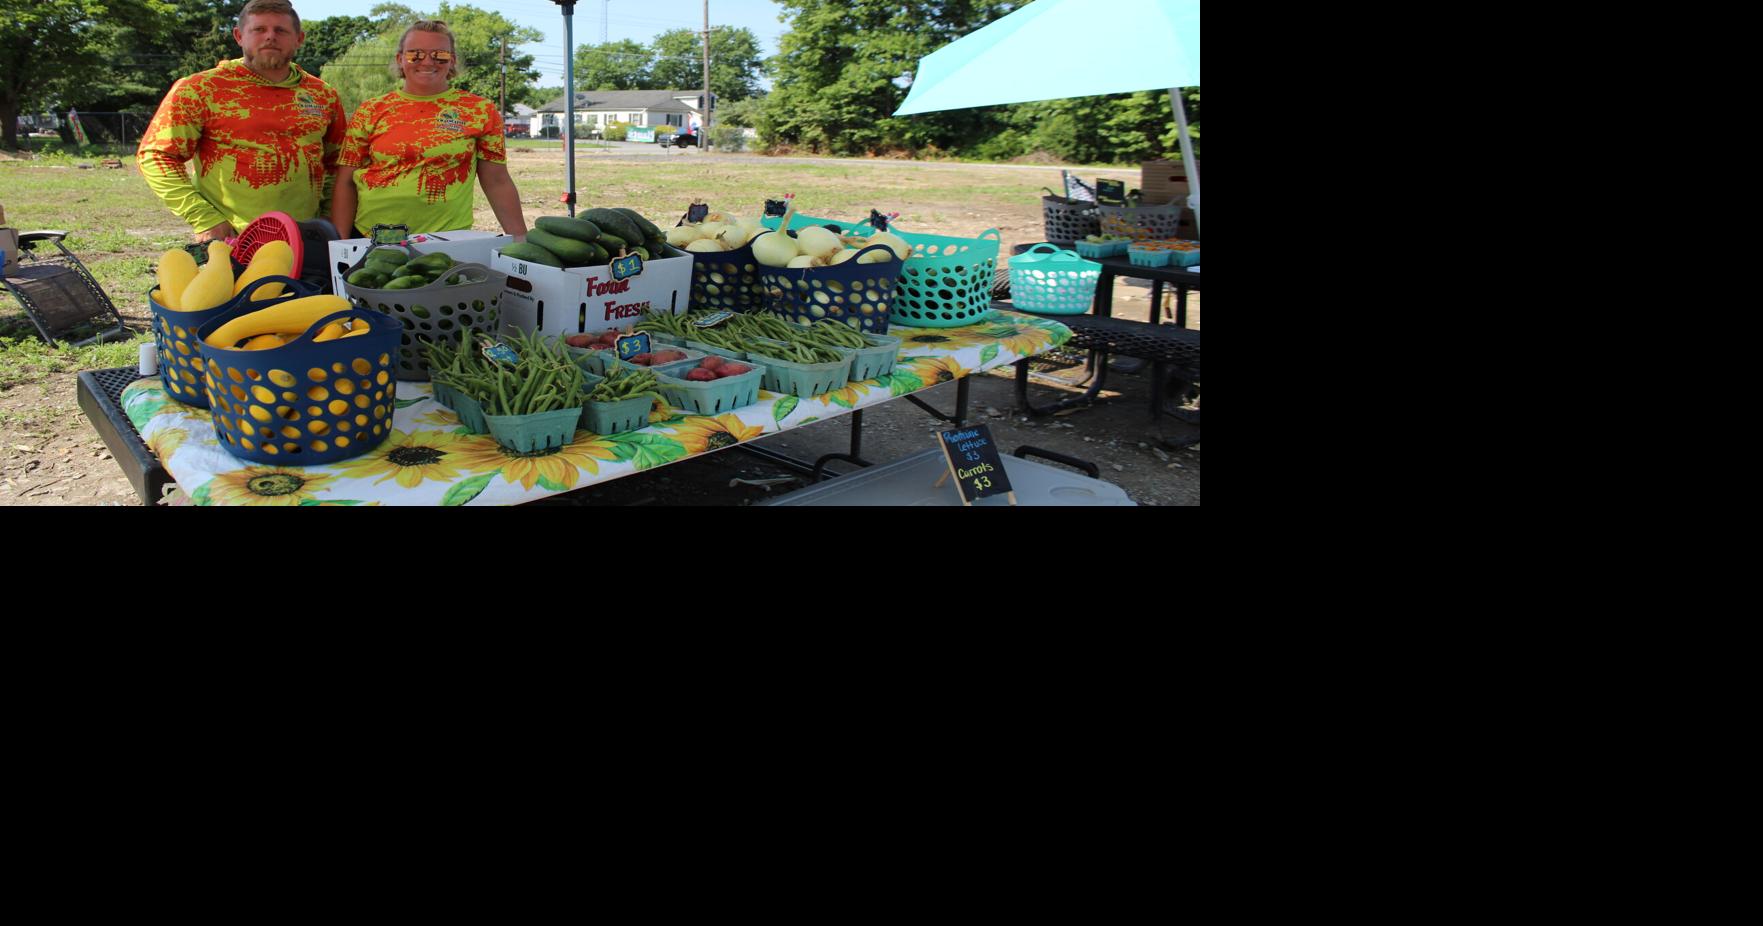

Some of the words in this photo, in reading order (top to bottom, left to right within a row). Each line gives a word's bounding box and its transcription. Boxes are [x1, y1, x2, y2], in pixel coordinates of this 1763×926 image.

[519, 263, 528, 276] BU
[958, 463, 993, 479] Carrots
[974, 476, 991, 490] $3
